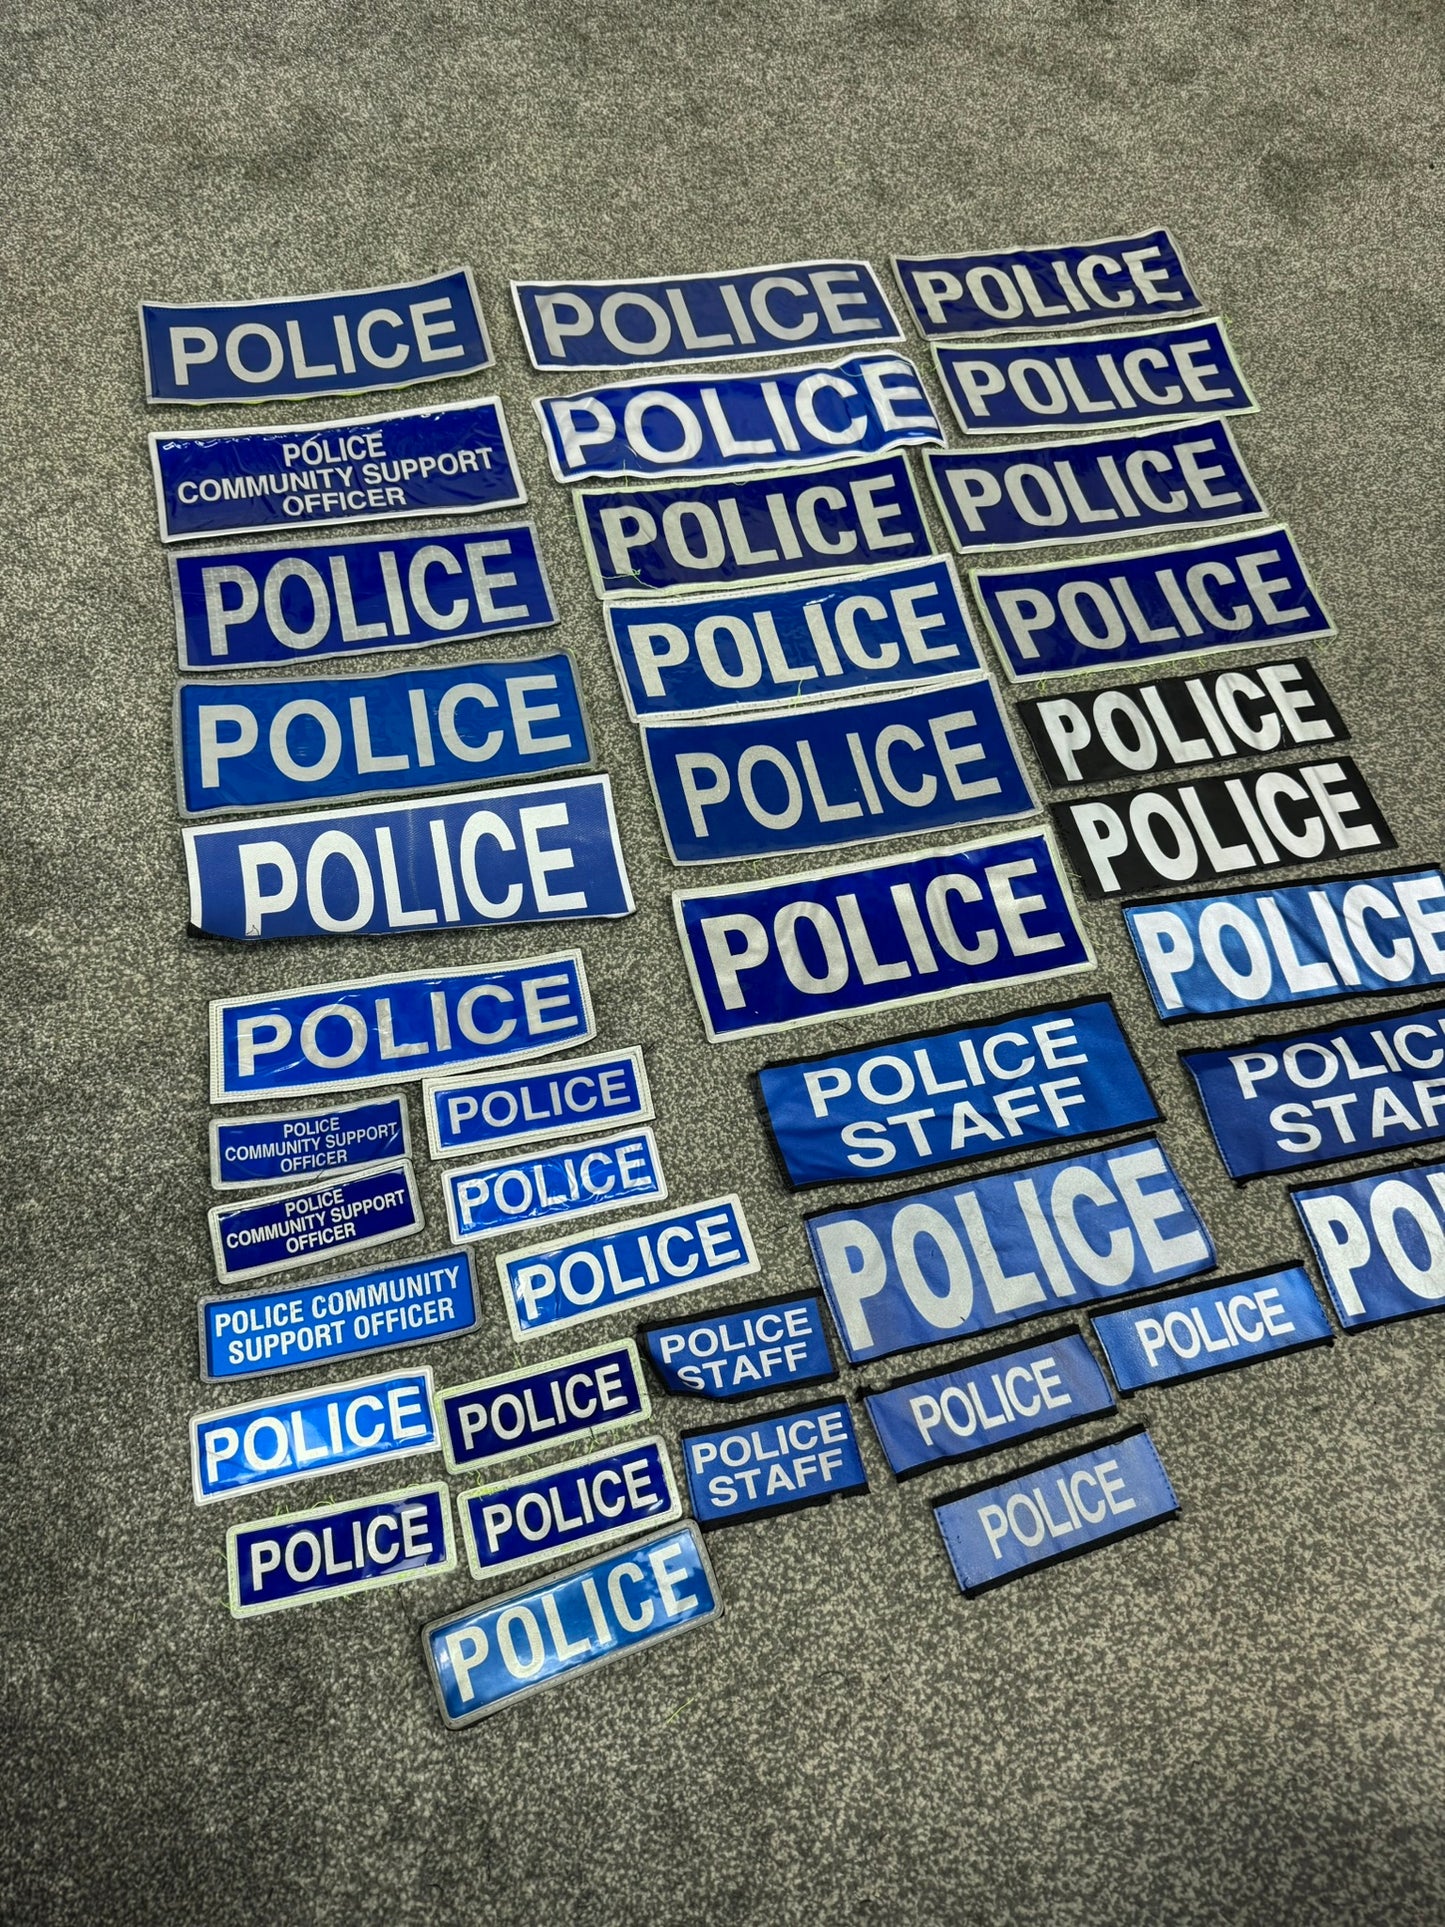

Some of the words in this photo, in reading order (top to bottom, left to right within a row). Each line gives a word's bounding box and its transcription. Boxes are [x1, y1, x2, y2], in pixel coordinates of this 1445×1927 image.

[534, 270, 882, 358] POLICE
[911, 245, 1184, 324] POLICE
[168, 297, 465, 386] POLICE
[951, 339, 1235, 417] POLICE
[282, 429, 387, 467] POLICE
[551, 360, 939, 469] POLICE
[178, 465, 353, 505] COMMUNITY
[363, 447, 494, 485] SUPPORT
[282, 489, 407, 516] OFFICER
[944, 438, 1241, 532] POLICE
[600, 474, 914, 575] POLICE
[201, 539, 530, 657] POLICE
[628, 581, 960, 697] POLICE
[995, 549, 1311, 660] POLICE
[198, 674, 572, 789] POLICE
[1036, 663, 1336, 782] POLICE
[674, 710, 1002, 838] POLICE
[238, 802, 588, 936] POLICE
[1069, 763, 1382, 892] POLICE
[700, 857, 1066, 1011] POLICE
[1132, 875, 1445, 1010] POLICE
[236, 973, 580, 1077] POLICE
[803, 1017, 1088, 1118] POLICE
[1229, 1019, 1445, 1100] POLIC
[225, 1137, 321, 1162] COMMUNITY
[325, 1122, 397, 1148] SUPPORT
[283, 1116, 341, 1138] POLICE
[448, 1069, 632, 1135] POLICE
[841, 1076, 1086, 1168] STAFF
[1269, 1080, 1445, 1154] STAF
[280, 1150, 348, 1173] OFFICER
[285, 1188, 344, 1218] POLICE
[458, 1143, 653, 1227] POLICE
[226, 1214, 325, 1249] COMMUNITY
[331, 1189, 405, 1221] SUPPORT
[286, 1223, 356, 1253] OFFICER
[815, 1146, 1209, 1352] POLICE
[214, 1300, 304, 1337] POLICE
[311, 1266, 460, 1319] COMMUNITY
[516, 1213, 742, 1321] POLICE
[228, 1321, 347, 1365] SUPPORT
[353, 1297, 455, 1340] OFFICER
[659, 1307, 812, 1364] POLICE
[677, 1341, 807, 1390] STAFF
[1135, 1287, 1296, 1368] POLICE
[204, 1386, 427, 1483] POLICE
[457, 1363, 629, 1450] POLICE
[691, 1412, 848, 1474] POLICE
[908, 1356, 1073, 1446] POLICE
[482, 1459, 658, 1553] POLICE
[708, 1448, 843, 1507] STAFF
[977, 1458, 1137, 1559] POLICE
[250, 1505, 433, 1591] POLICE
[446, 1543, 699, 1703] POLICE
